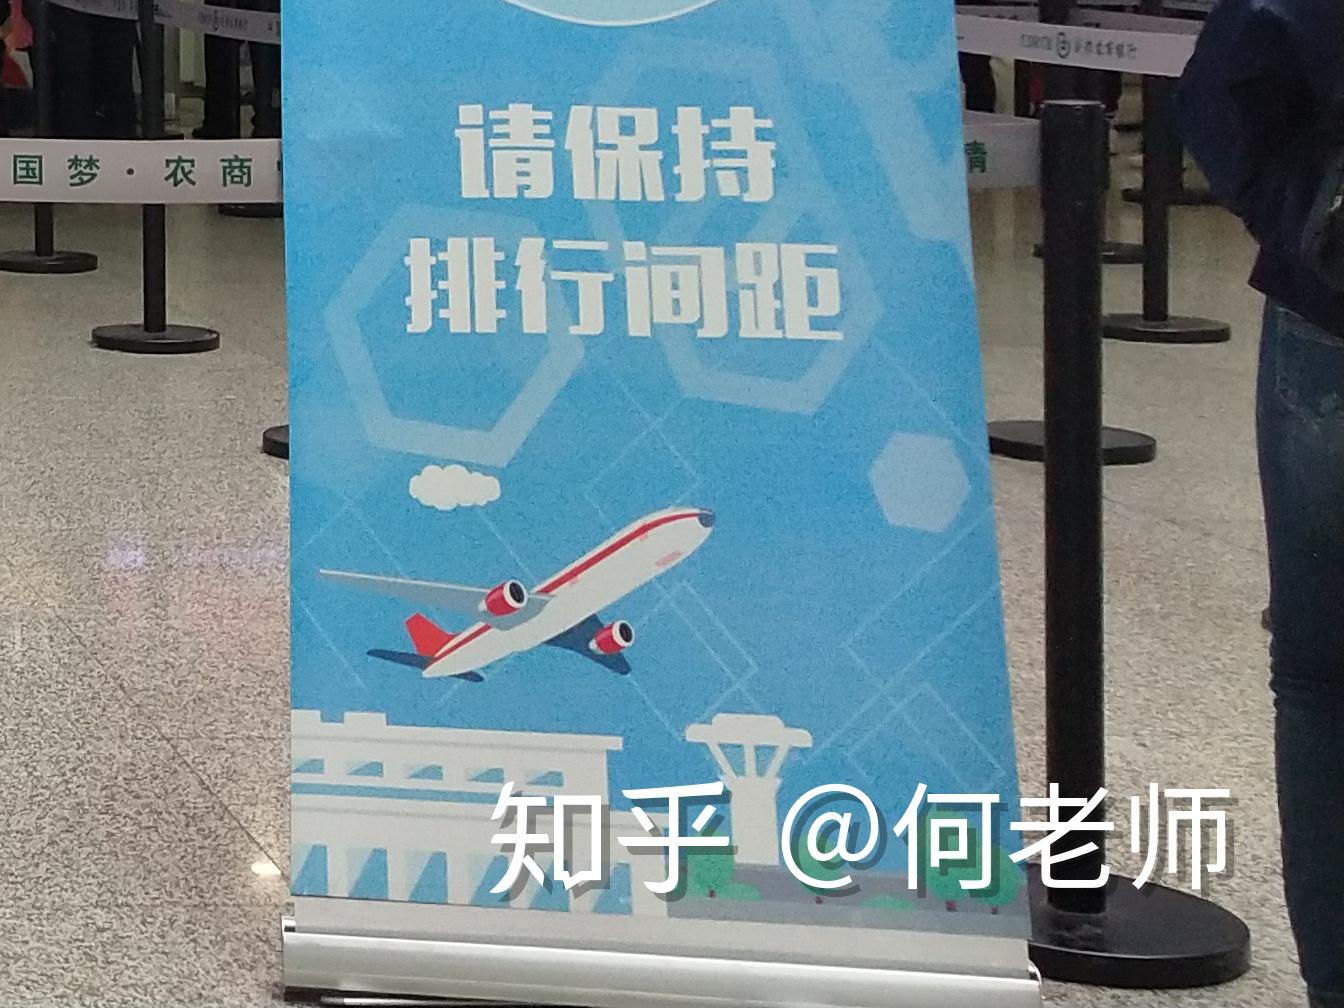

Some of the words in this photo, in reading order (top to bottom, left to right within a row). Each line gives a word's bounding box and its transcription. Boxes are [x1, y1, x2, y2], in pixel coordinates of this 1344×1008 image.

[453, 103, 777, 203] 请保持
[404, 236, 844, 341] 排行间距
